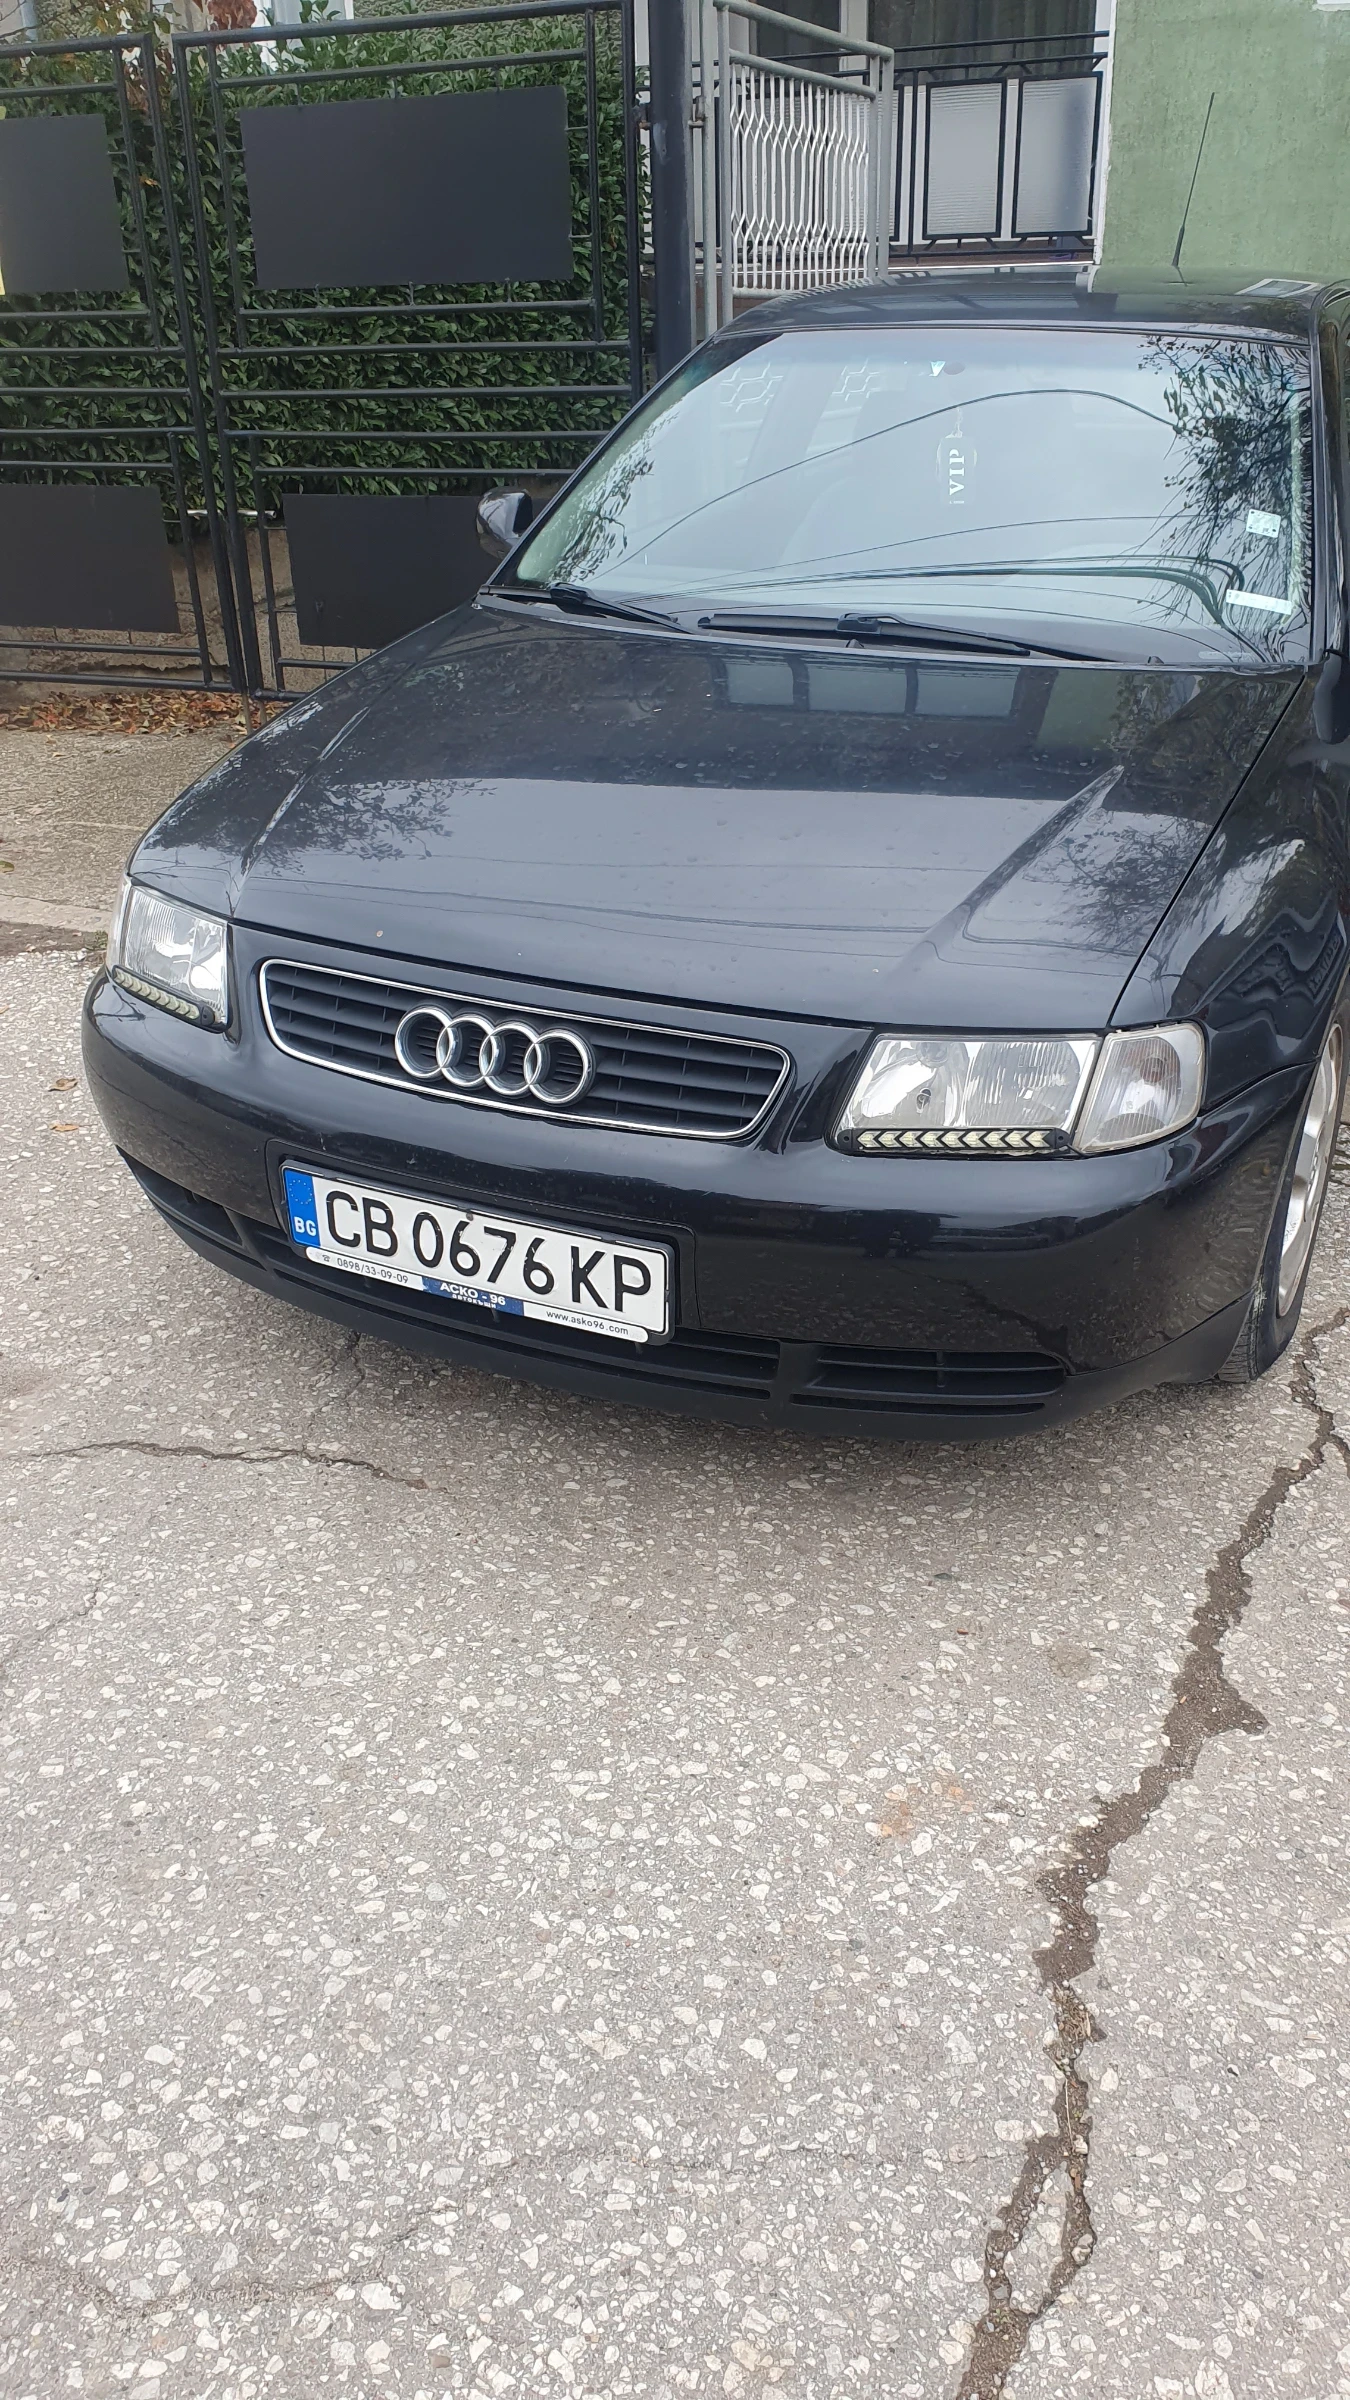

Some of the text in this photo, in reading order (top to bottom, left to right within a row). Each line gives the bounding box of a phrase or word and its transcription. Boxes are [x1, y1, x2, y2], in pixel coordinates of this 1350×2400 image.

[949, 448, 965, 496] VIP
[294, 1216, 318, 1238] BG
[412, 1211, 555, 1295] 0676
[336, 1257, 409, 1284] 0898/33-09-09
[490, 1293, 506, 1306] 96
[545, 1310, 629, 1336] www.asko96.com
